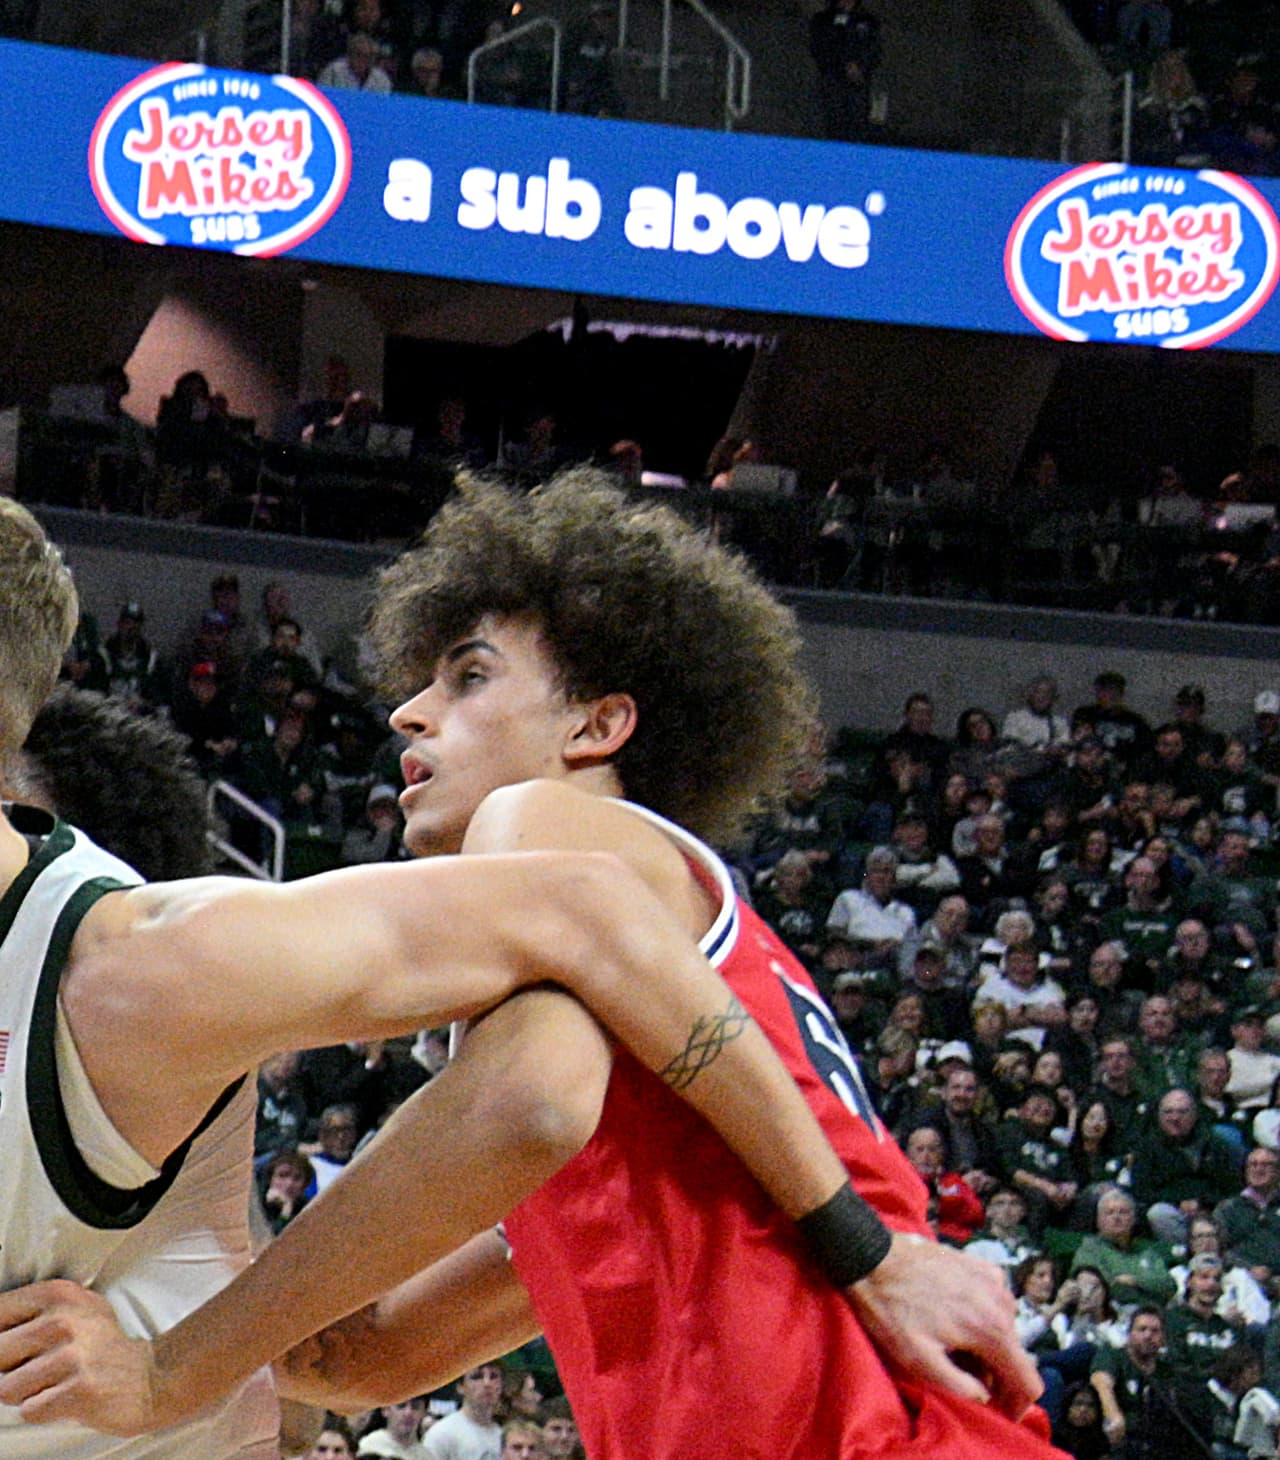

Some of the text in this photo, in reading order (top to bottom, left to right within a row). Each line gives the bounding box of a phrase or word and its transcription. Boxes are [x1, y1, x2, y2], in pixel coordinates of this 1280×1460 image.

[128, 102, 310, 163] Jersey
[143, 156, 309, 212] Mike's
[383, 156, 871, 268] a sub above
[190, 213, 262, 244] SUBS
[1045, 203, 1240, 259] Jersey
[1062, 252, 1241, 312] Mike's
[1113, 307, 1190, 339] SUBS
